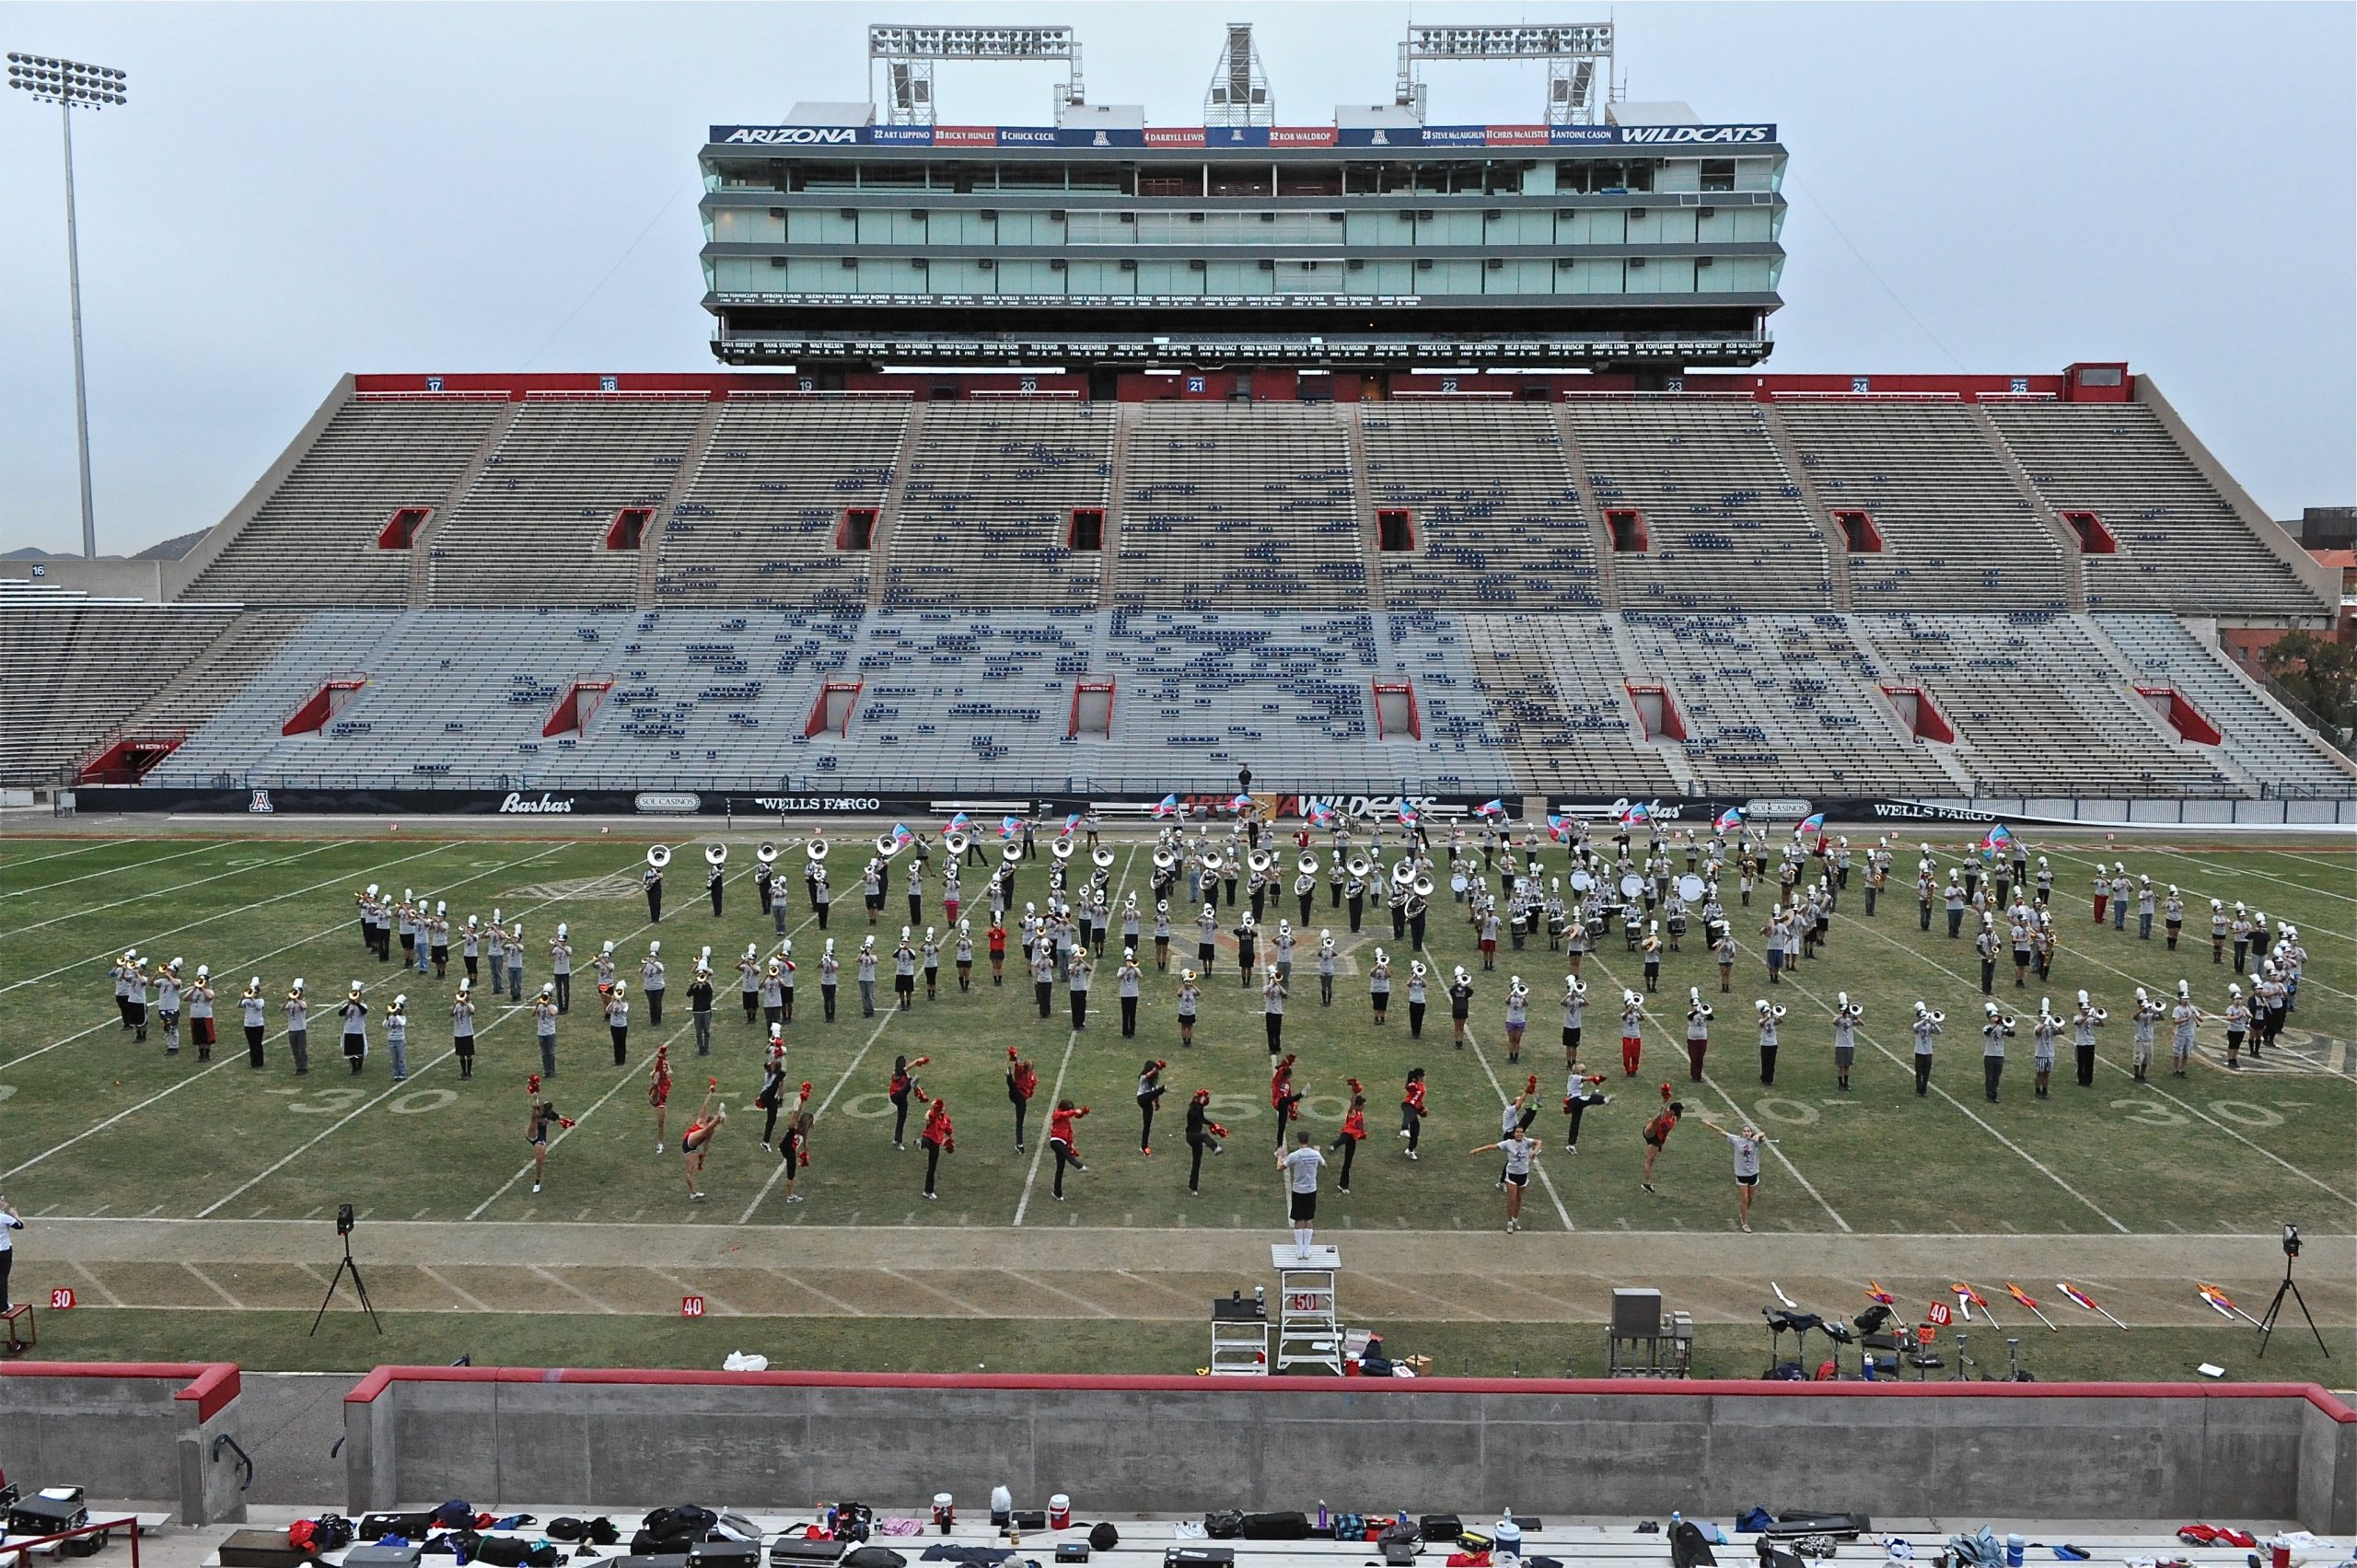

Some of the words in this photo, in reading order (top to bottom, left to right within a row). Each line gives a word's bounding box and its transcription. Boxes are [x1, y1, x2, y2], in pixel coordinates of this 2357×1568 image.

[725, 129, 856, 144] ARIZONA
[968, 132, 995, 140] HUNLEY
[1422, 131, 1431, 139] 28
[1621, 128, 1768, 143] WILDCATS
[429, 382, 440, 391] 17
[603, 381, 615, 391] 18
[800, 381, 812, 391] 19
[1021, 381, 1036, 391] 20
[1190, 381, 1202, 391] 21
[1443, 382, 1457, 391] 22
[1668, 382, 1682, 391] 23
[1853, 383, 1867, 392] 24
[2012, 383, 2026, 393] 25
[33, 566, 44, 575] 16
[250, 790, 273, 812] A
[499, 792, 574, 812] Bashas'
[762, 798, 820, 810] WELLS
[823, 798, 880, 810] FARGO
[1874, 804, 1933, 817] WELLS
[52, 1290, 71, 1308] 30
[1296, 1294, 1315, 1310] 50
[684, 1298, 702, 1315] 40
[1930, 1304, 1947, 1323] 40
